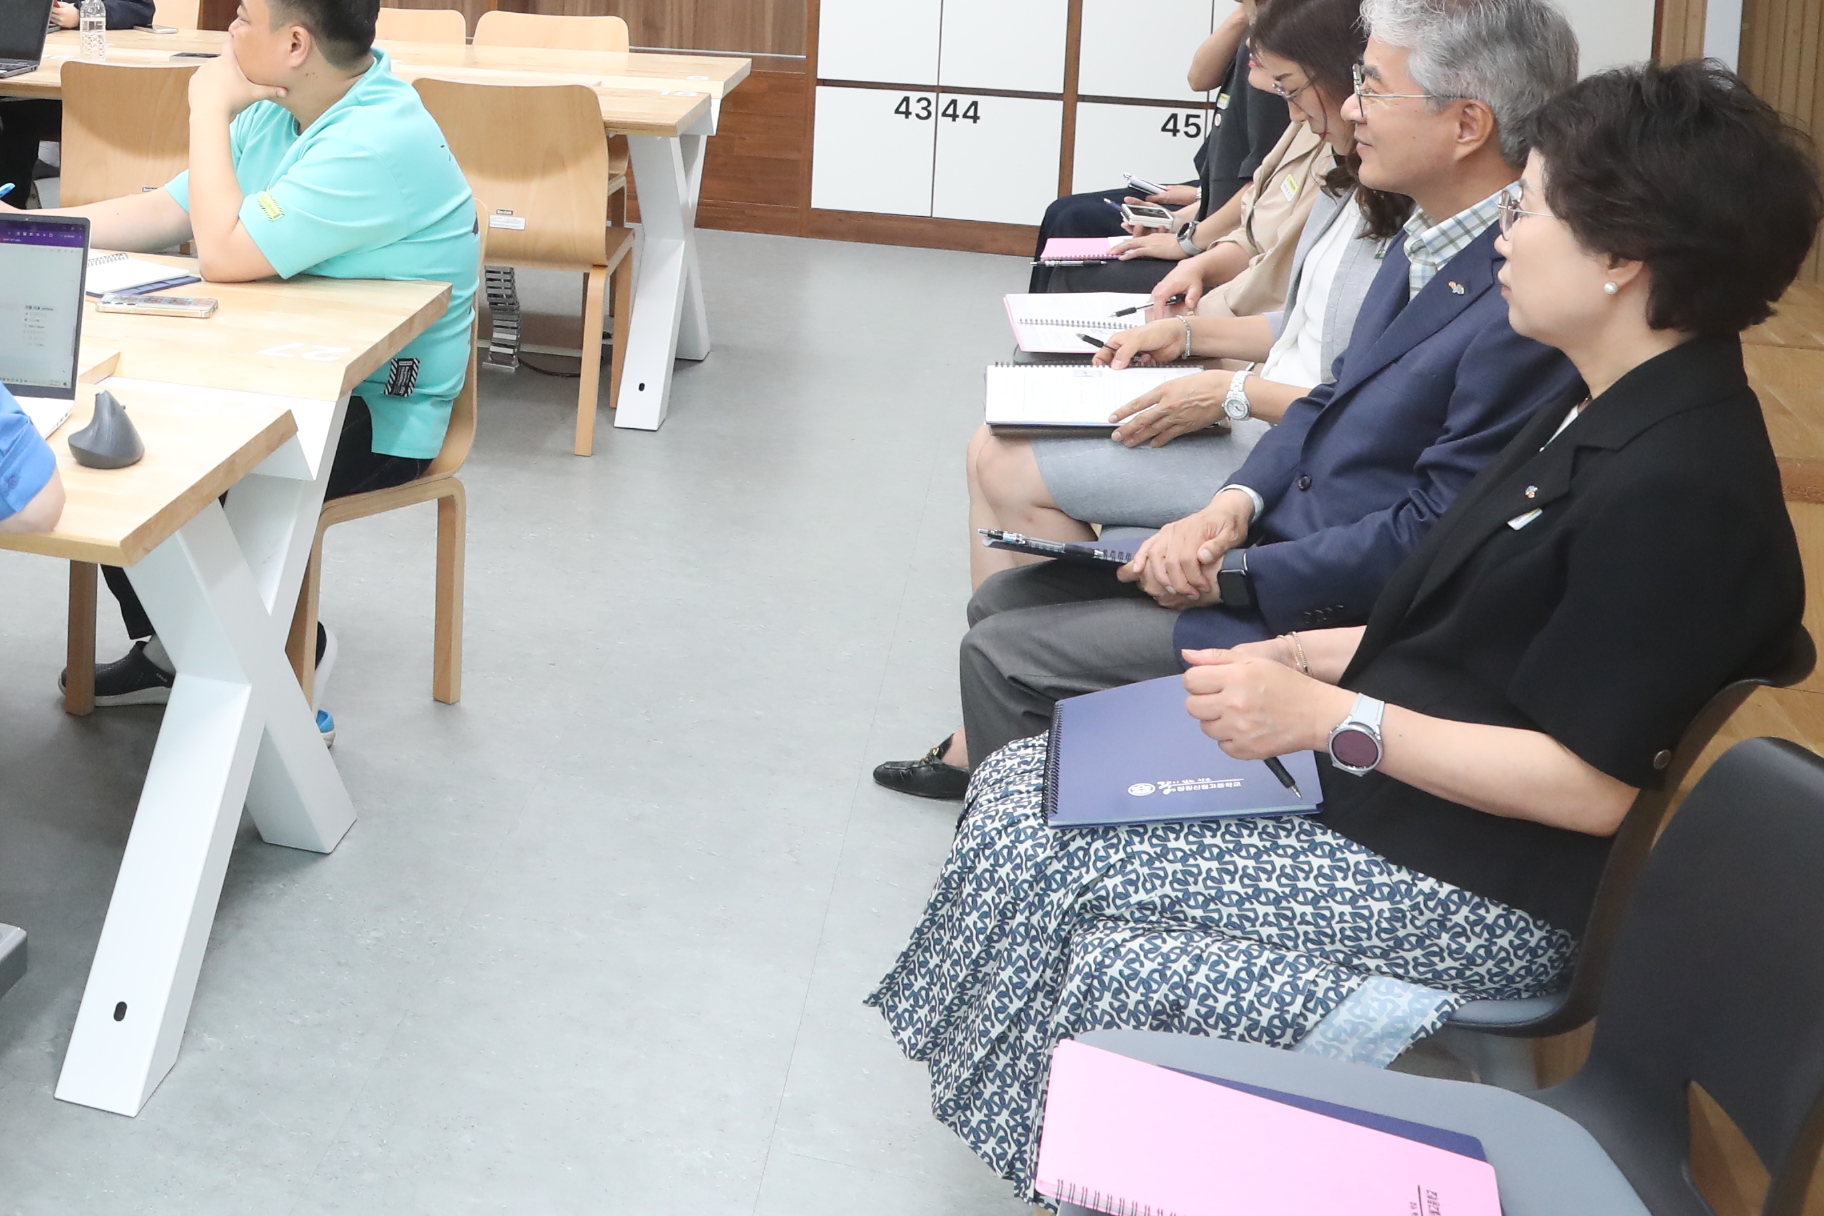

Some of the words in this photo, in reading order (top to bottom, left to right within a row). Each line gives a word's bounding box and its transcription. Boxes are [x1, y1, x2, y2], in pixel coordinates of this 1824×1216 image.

[894, 97, 932, 121] 43
[942, 99, 981, 123] 44
[1160, 114, 1202, 139] 45
